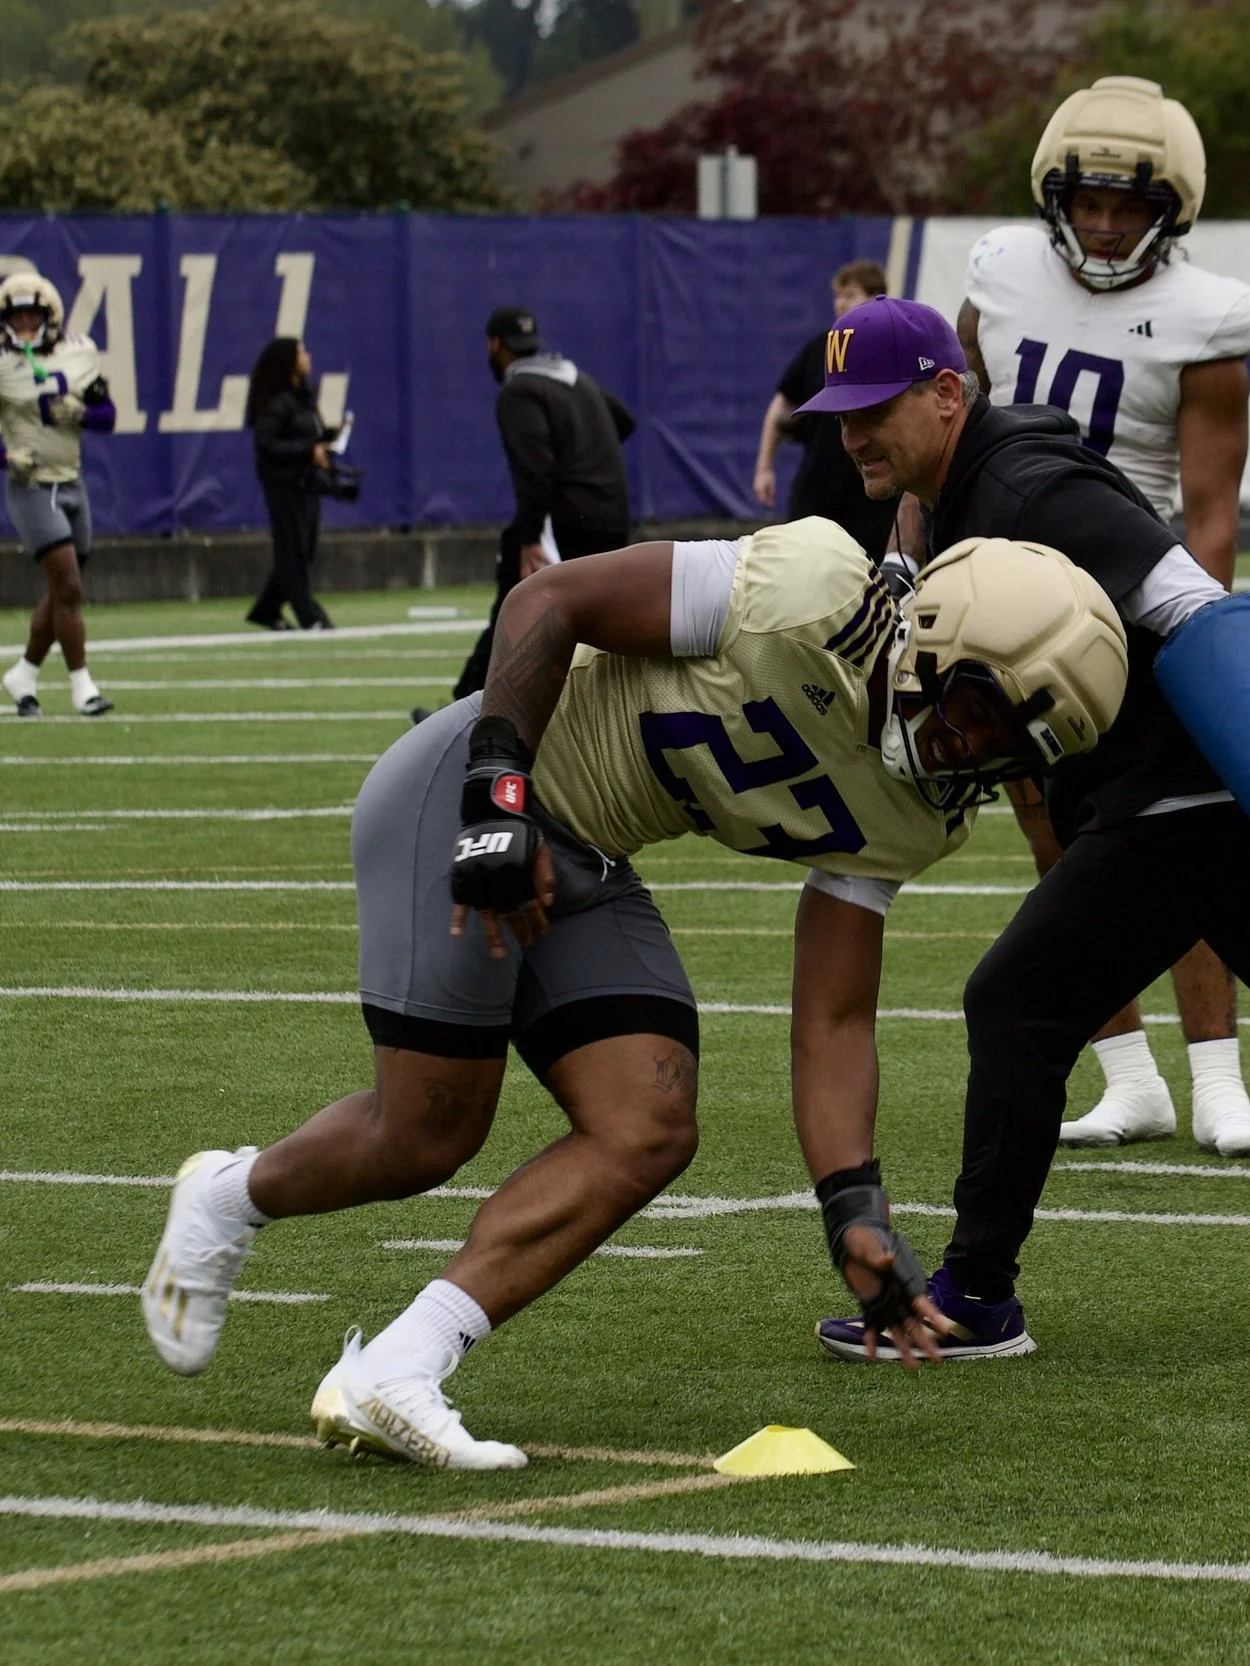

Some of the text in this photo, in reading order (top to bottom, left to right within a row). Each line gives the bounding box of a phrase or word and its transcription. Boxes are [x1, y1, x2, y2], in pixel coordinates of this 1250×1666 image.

[0, 252, 350, 434] ALL
[827, 328, 855, 374] W
[1012, 337, 1125, 458] 10
[801, 683, 829, 717] adidas
[504, 781, 517, 804] UFC
[453, 831, 514, 862] UFC
